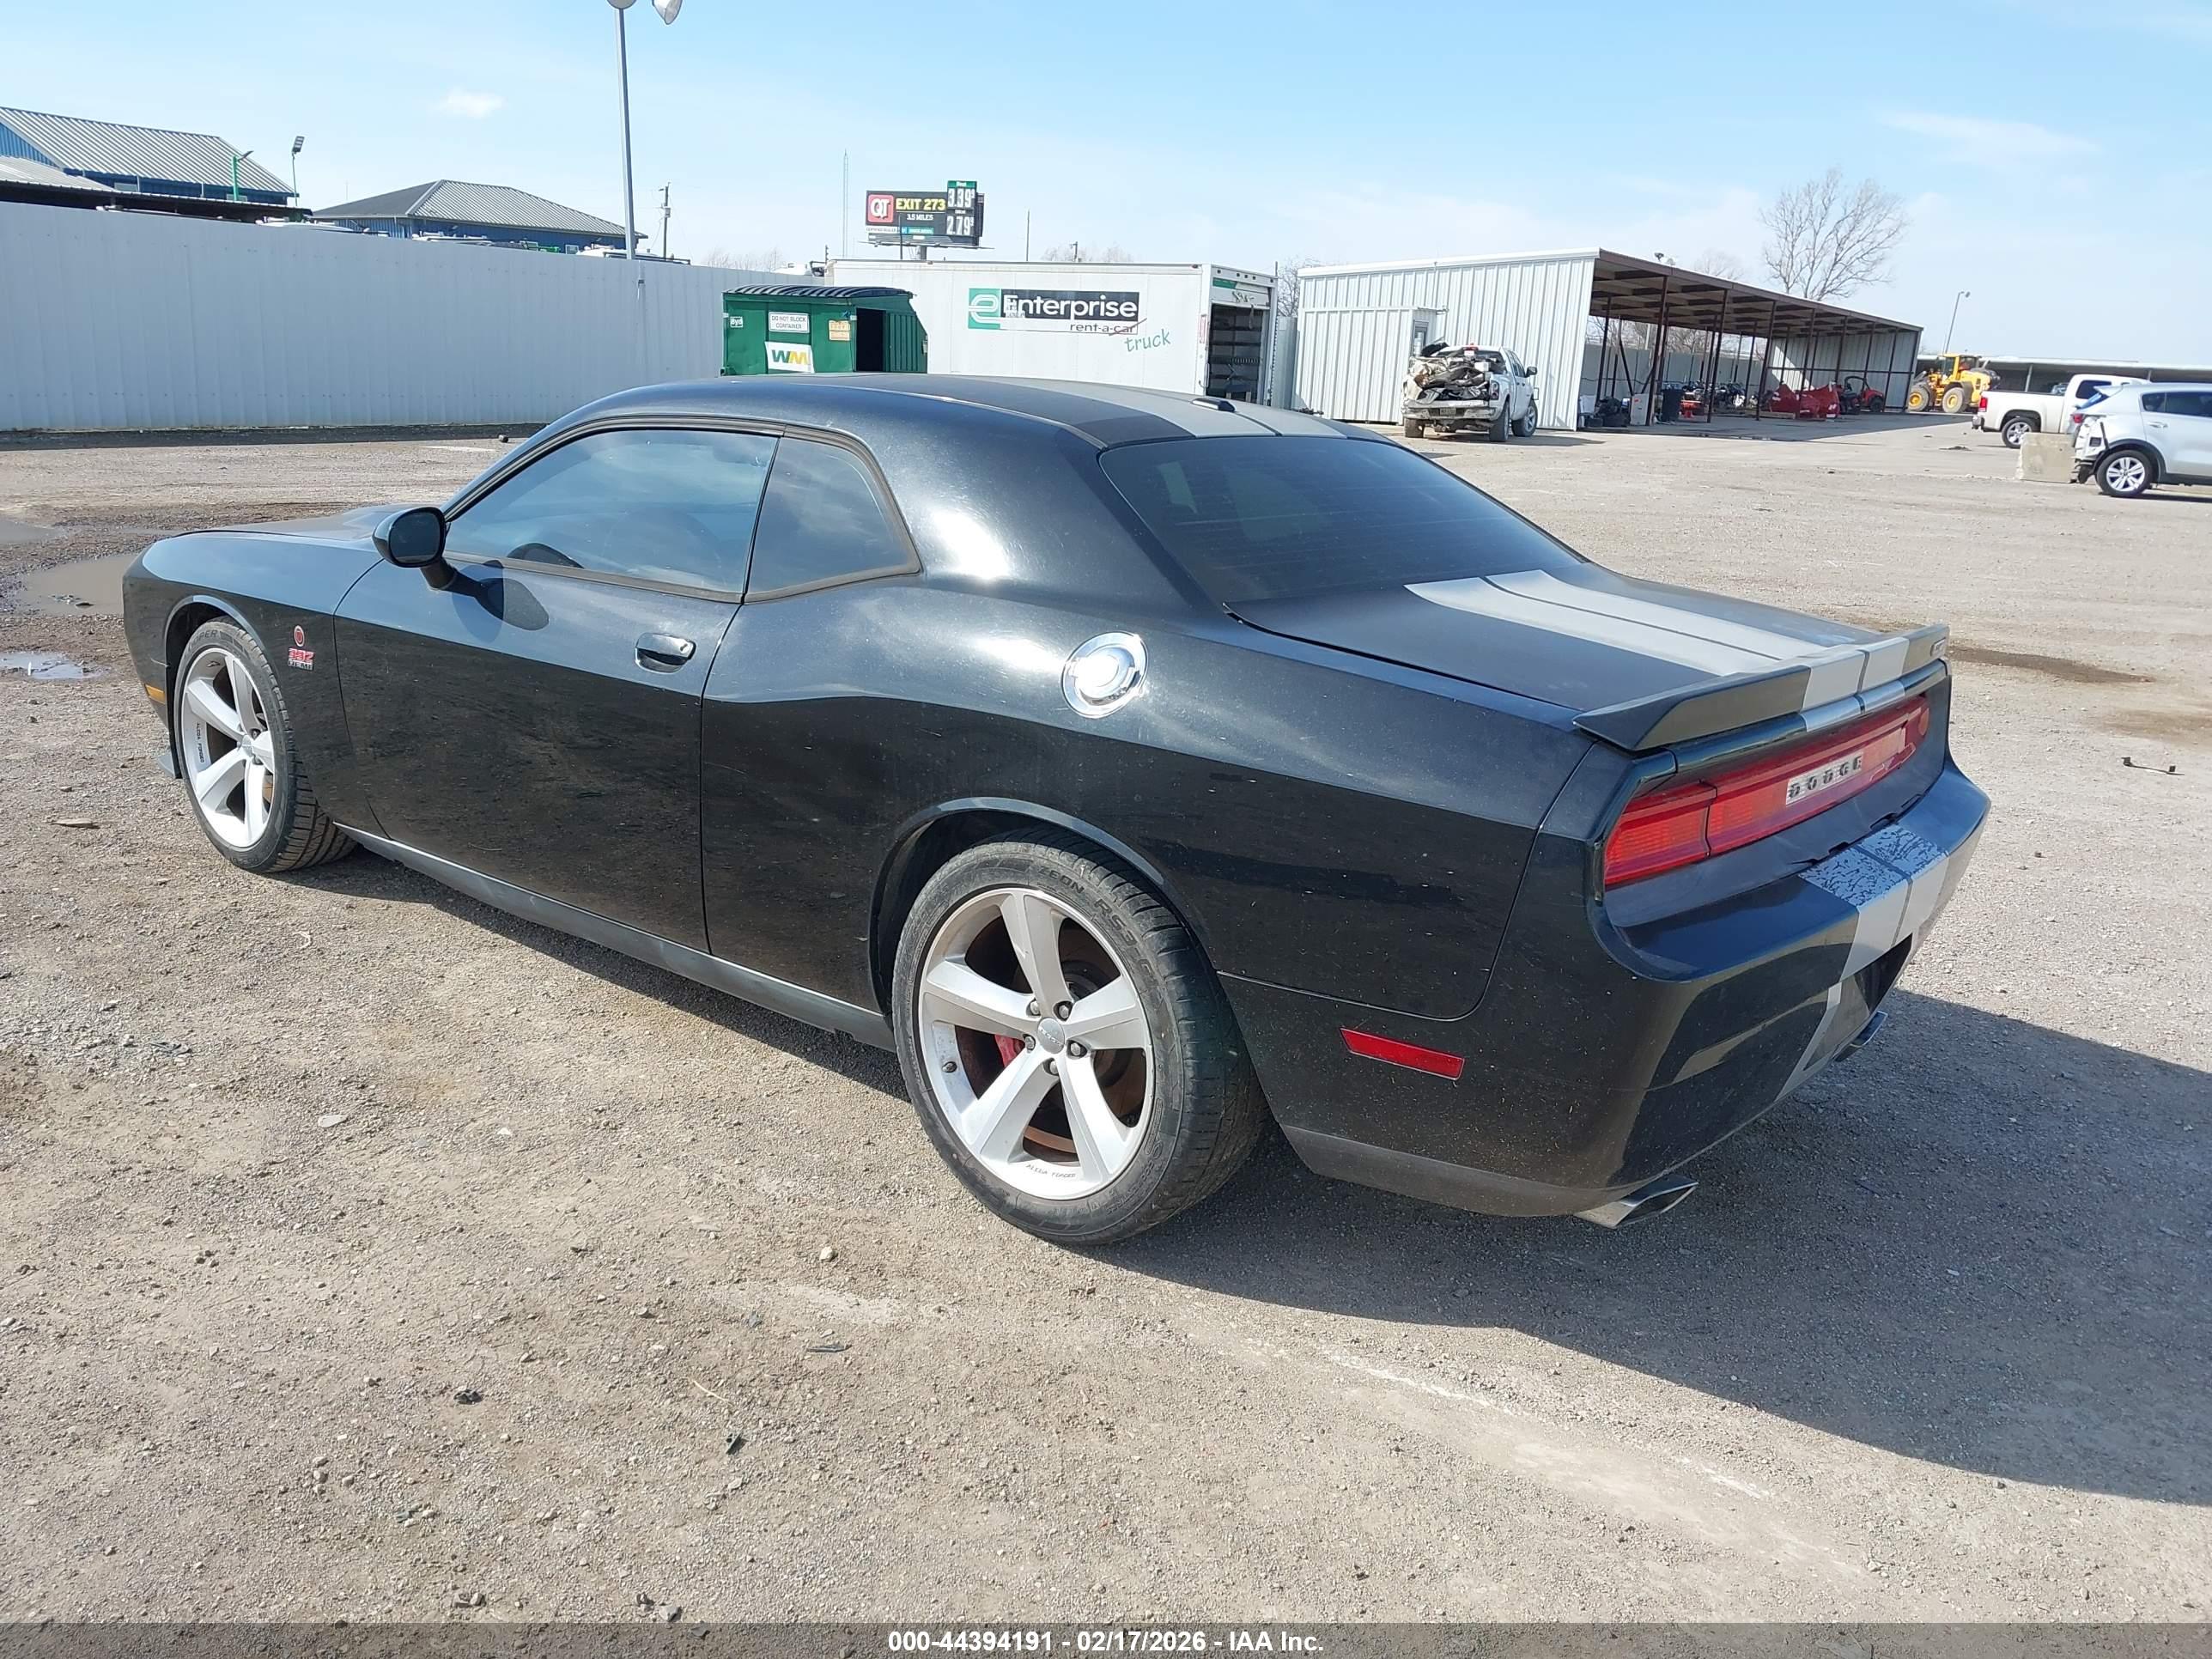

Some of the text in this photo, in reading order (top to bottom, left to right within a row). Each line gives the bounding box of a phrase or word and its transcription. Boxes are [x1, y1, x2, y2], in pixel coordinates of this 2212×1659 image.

[871, 198, 891, 219] QT
[895, 198, 945, 210] EXIT 273
[1003, 295, 1138, 319] Enterprise
[1070, 323, 1134, 333] rent-a-car
[1124, 329, 1171, 352] truck
[772, 349, 811, 365] WM
[1789, 756, 1863, 799] DODGE
[1037, 866, 1085, 895] ZEON
